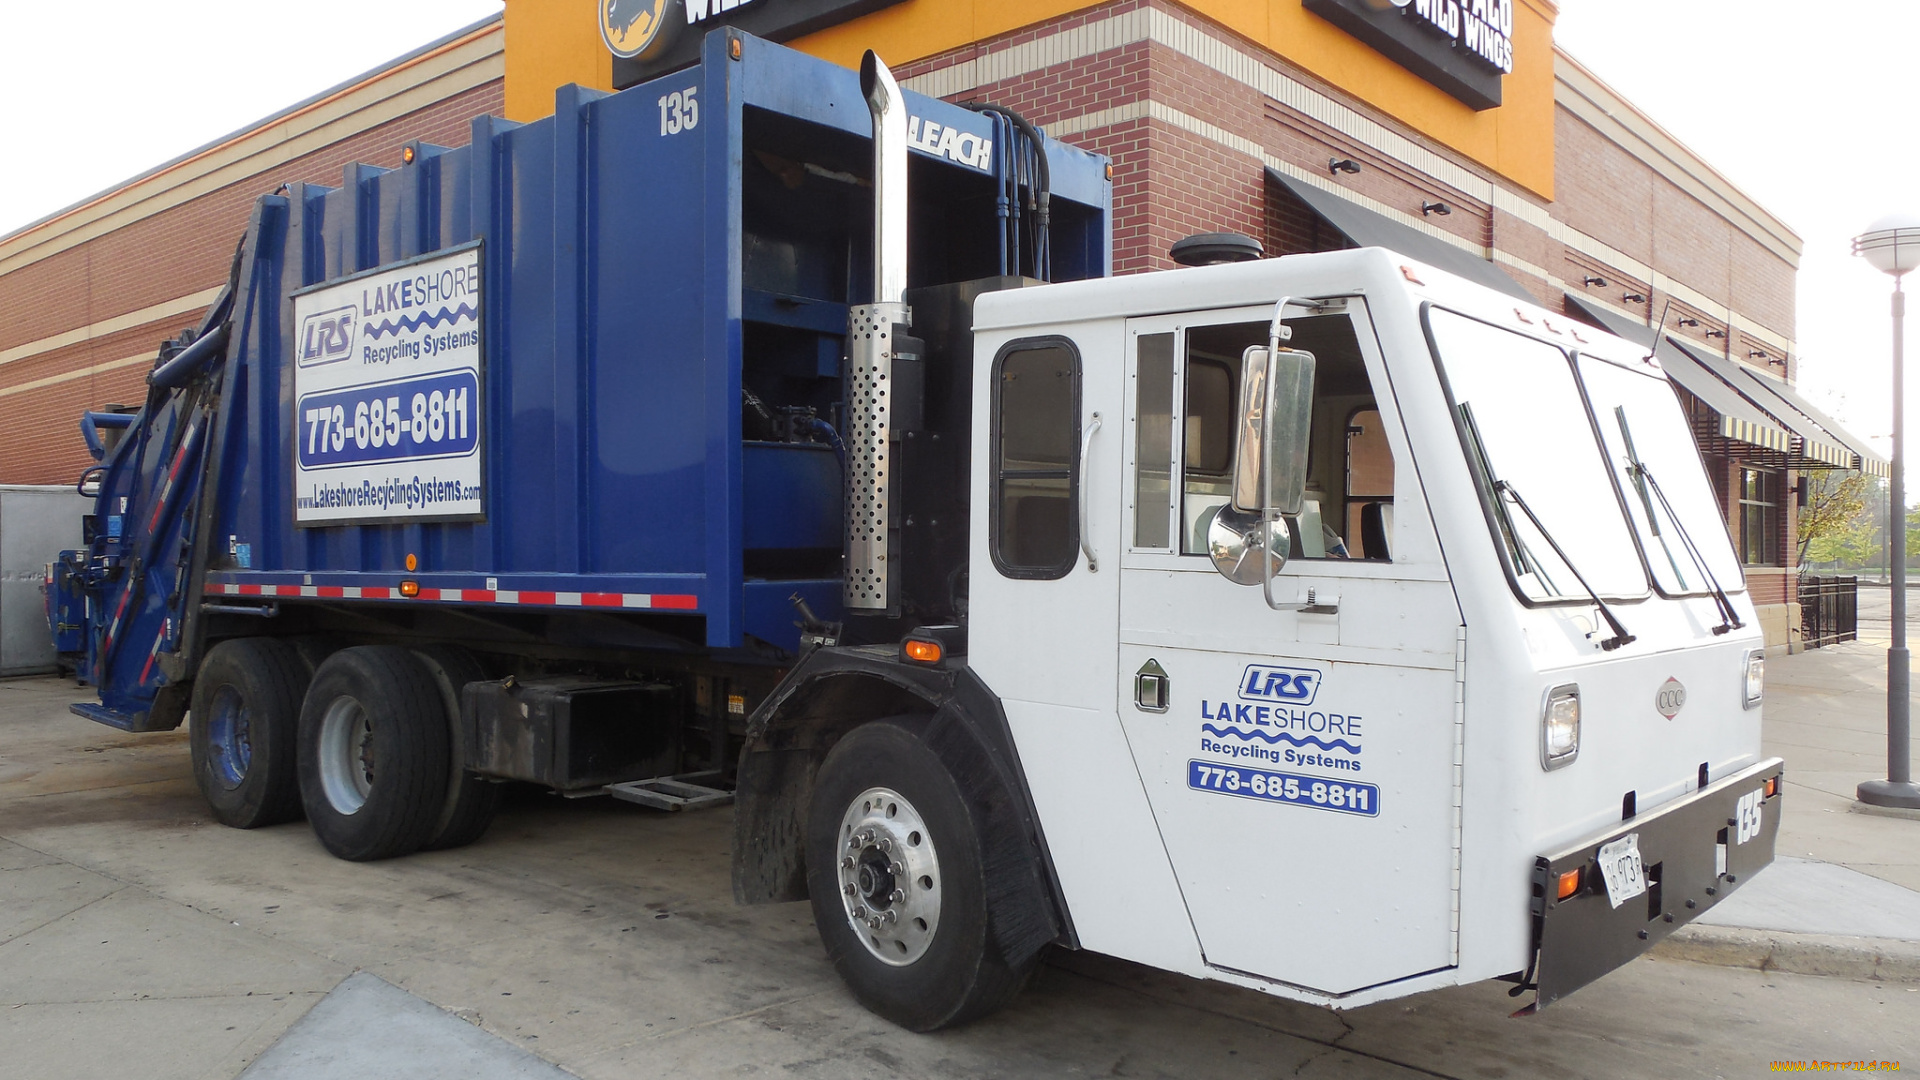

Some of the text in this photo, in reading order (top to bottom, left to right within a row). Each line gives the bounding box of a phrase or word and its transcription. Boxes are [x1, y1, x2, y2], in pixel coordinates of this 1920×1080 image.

[1463, 8, 1513, 74] WINGS
[658, 86, 699, 137] 135
[907, 115, 992, 170] LEACH
[363, 264, 478, 317] LAKESHORE
[303, 315, 352, 362] LRS
[363, 329, 478, 365] Recycling Systems
[305, 387, 468, 455] 773-685-8811
[1246, 670, 1313, 700] LRS
[1659, 689, 1683, 709] CCC
[1201, 699, 1363, 737] LAKESHORE
[1201, 738, 1362, 771] Recycling Systems
[1197, 765, 1369, 811] 773-685-8811
[1736, 788, 1763, 846] 135
[1618, 855, 1636, 884] 973
